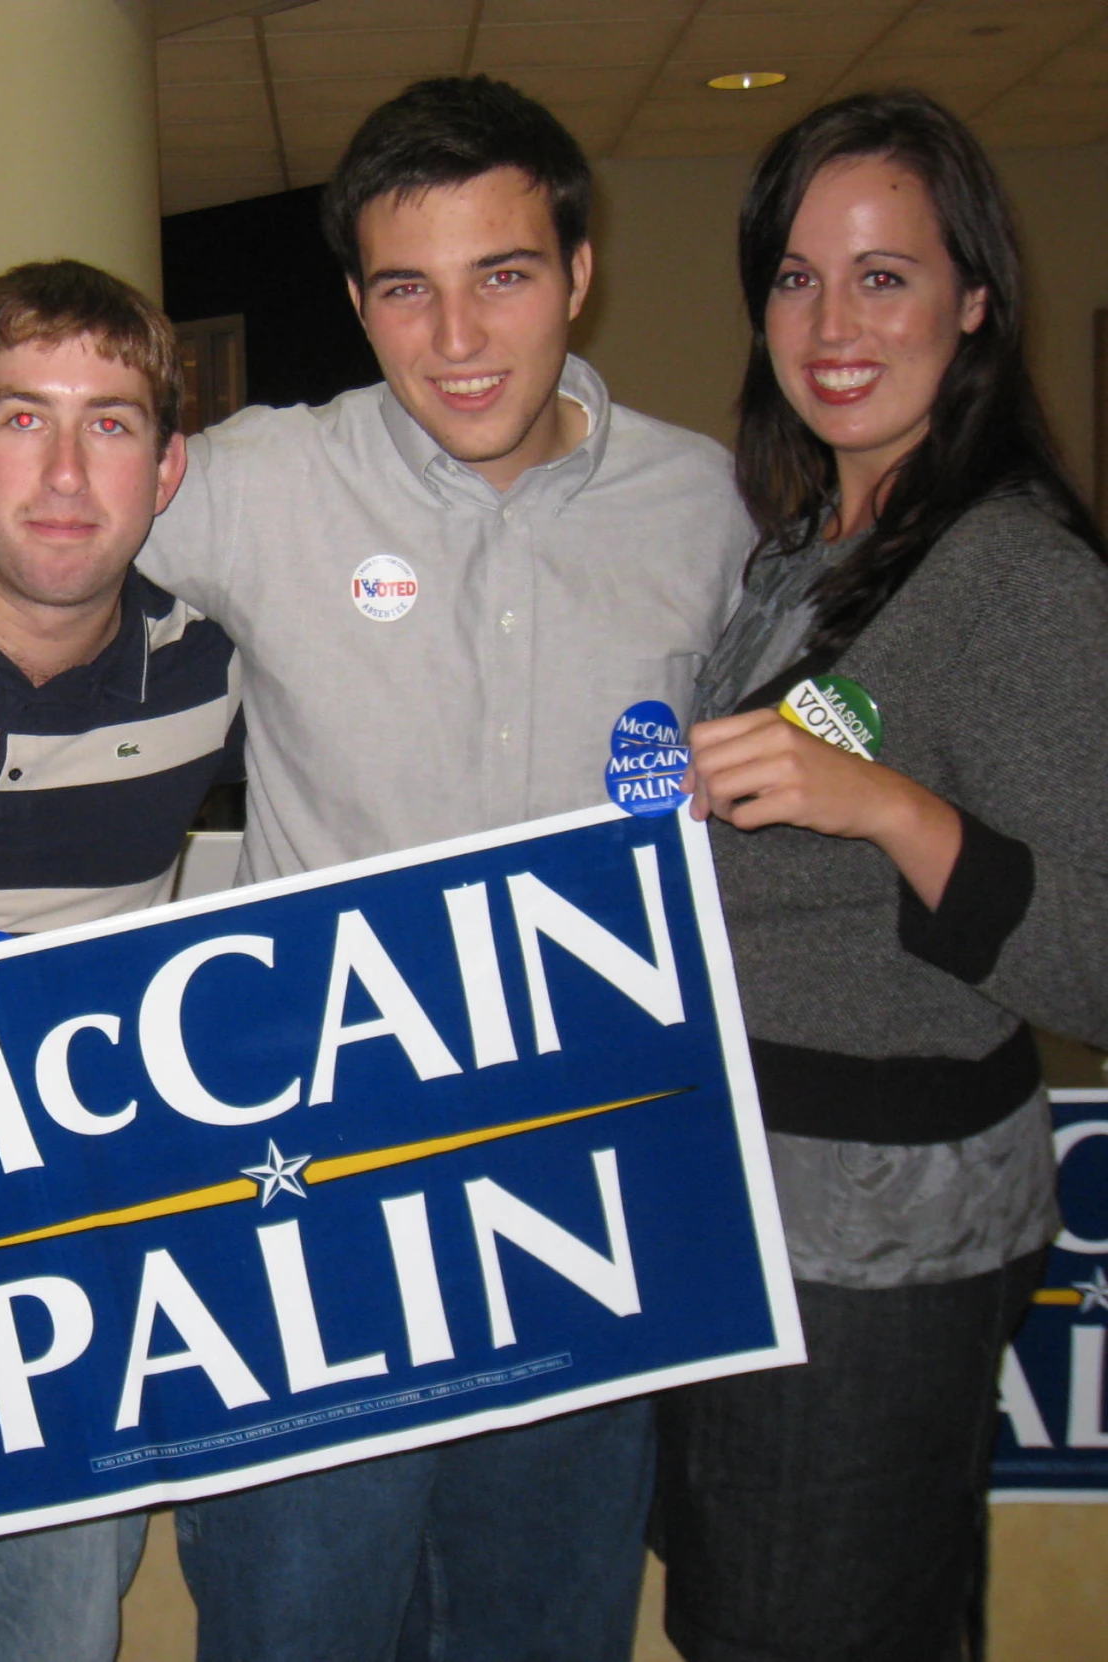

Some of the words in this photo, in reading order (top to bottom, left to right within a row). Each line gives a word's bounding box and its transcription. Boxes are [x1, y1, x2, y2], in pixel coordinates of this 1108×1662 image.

[354, 579, 360, 598] I
[361, 579, 416, 597] VOTED
[822, 684, 874, 744] MASON
[616, 715, 679, 745] McCAIN
[609, 749, 690, 775] McCAIN
[618, 776, 683, 803] PALIN
